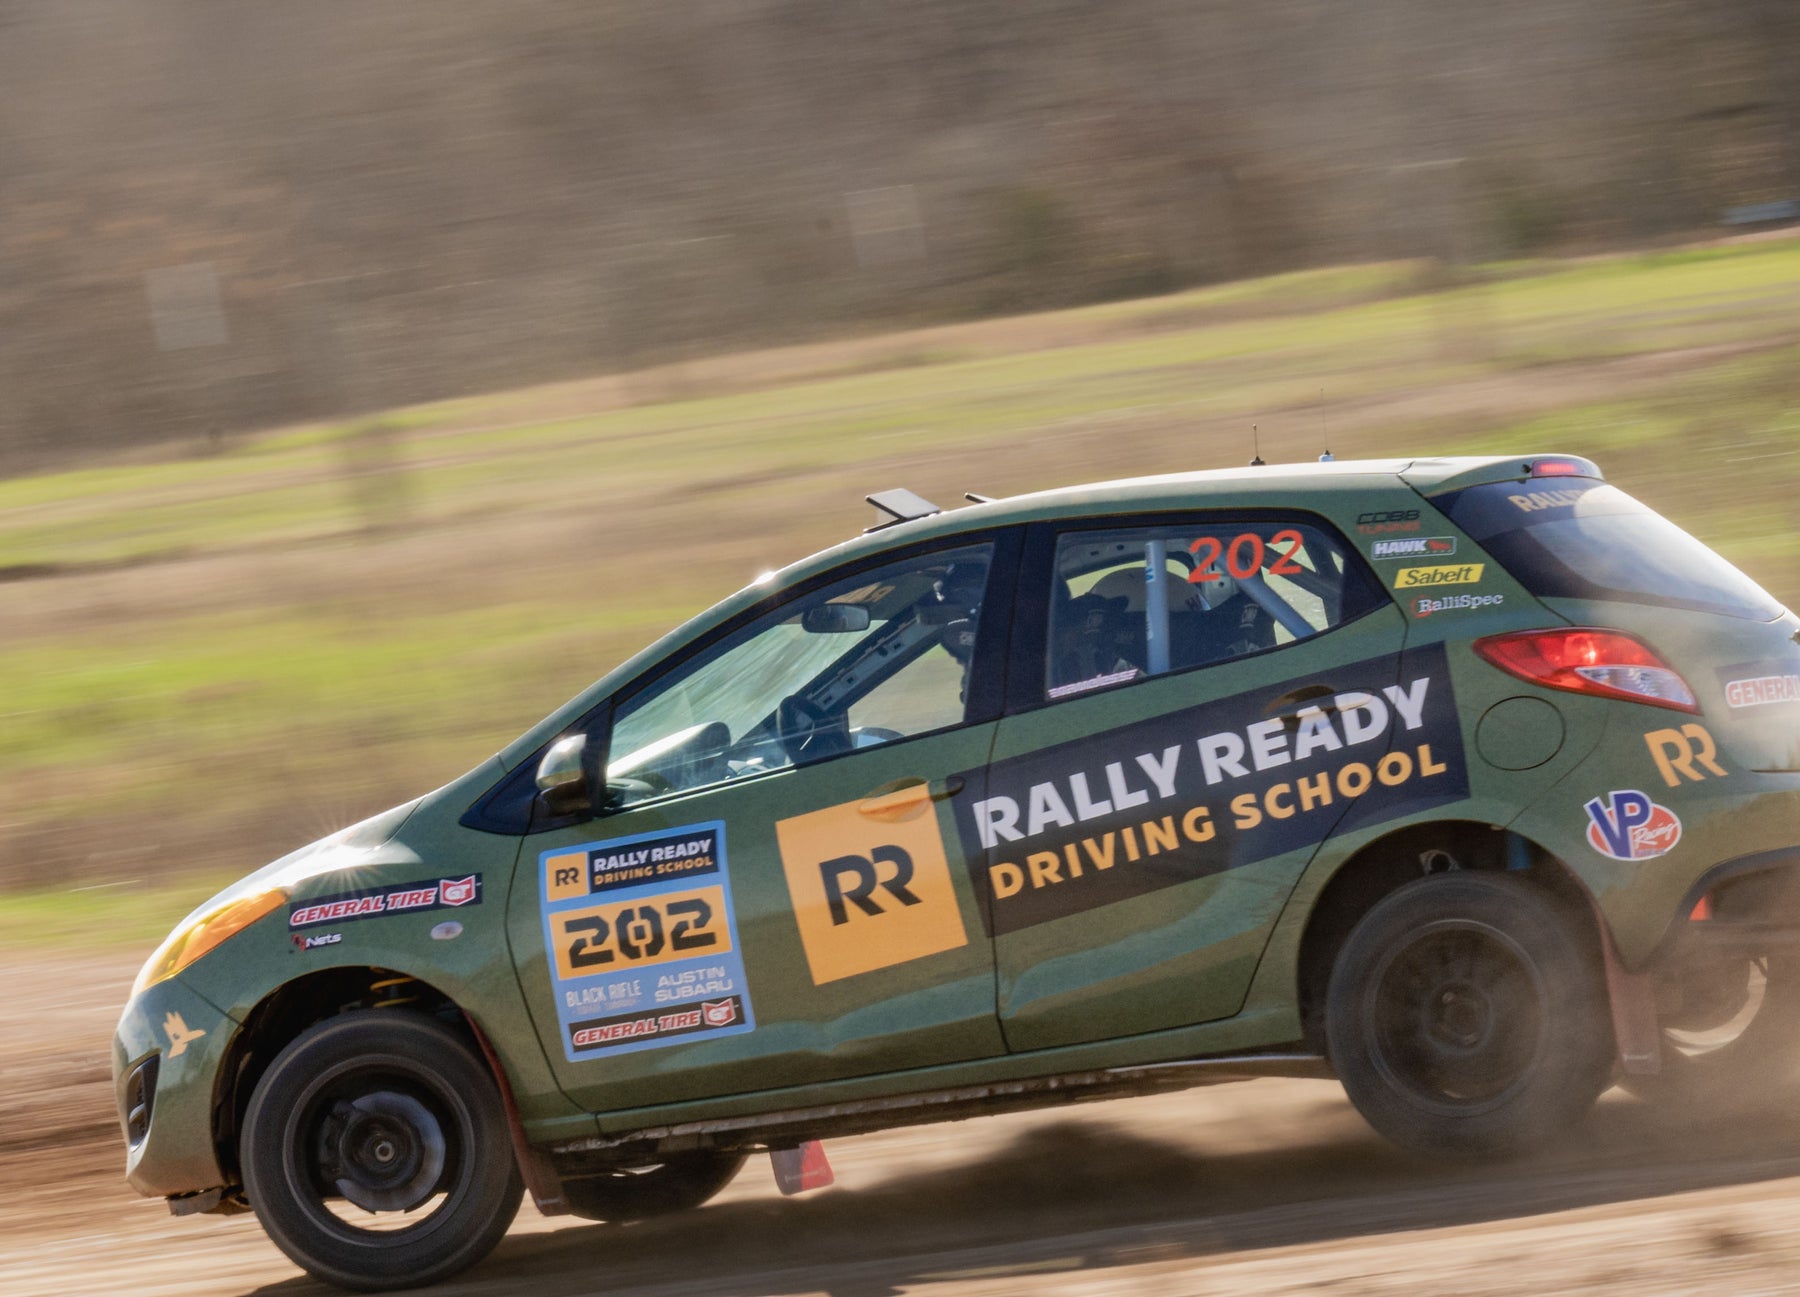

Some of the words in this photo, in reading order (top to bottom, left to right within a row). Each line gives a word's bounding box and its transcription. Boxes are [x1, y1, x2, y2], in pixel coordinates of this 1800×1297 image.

[1187, 529, 1304, 584] 202
[1374, 539, 1428, 555] HAWK
[1404, 566, 1474, 586] Sabelt
[1418, 593, 1504, 613] RalliSpec
[972, 744, 1182, 849] RALLY
[1196, 676, 1431, 786] READY
[1643, 723, 1729, 788] RR
[989, 806, 1216, 900] DRIVING
[1230, 744, 1446, 829] SCHOOL
[1584, 790, 1653, 860] VP
[1632, 821, 1680, 850] Racing
[594, 850, 648, 872] RALLY
[651, 839, 712, 857] READY
[594, 866, 653, 886] DRIVING
[657, 856, 713, 874] SCHOOL
[555, 867, 580, 887] RR
[819, 844, 922, 926] RR
[290, 895, 385, 926] GENERAL
[385, 887, 438, 910] TIRE
[564, 898, 717, 969] 202
[654, 979, 733, 1003] SUBARU
[657, 966, 726, 988] AUSTIN
[565, 986, 607, 1008] BLACK
[608, 980, 642, 1001] RIFLE
[573, 1018, 658, 1046] GENERAL
[658, 1010, 702, 1031] TIRE
